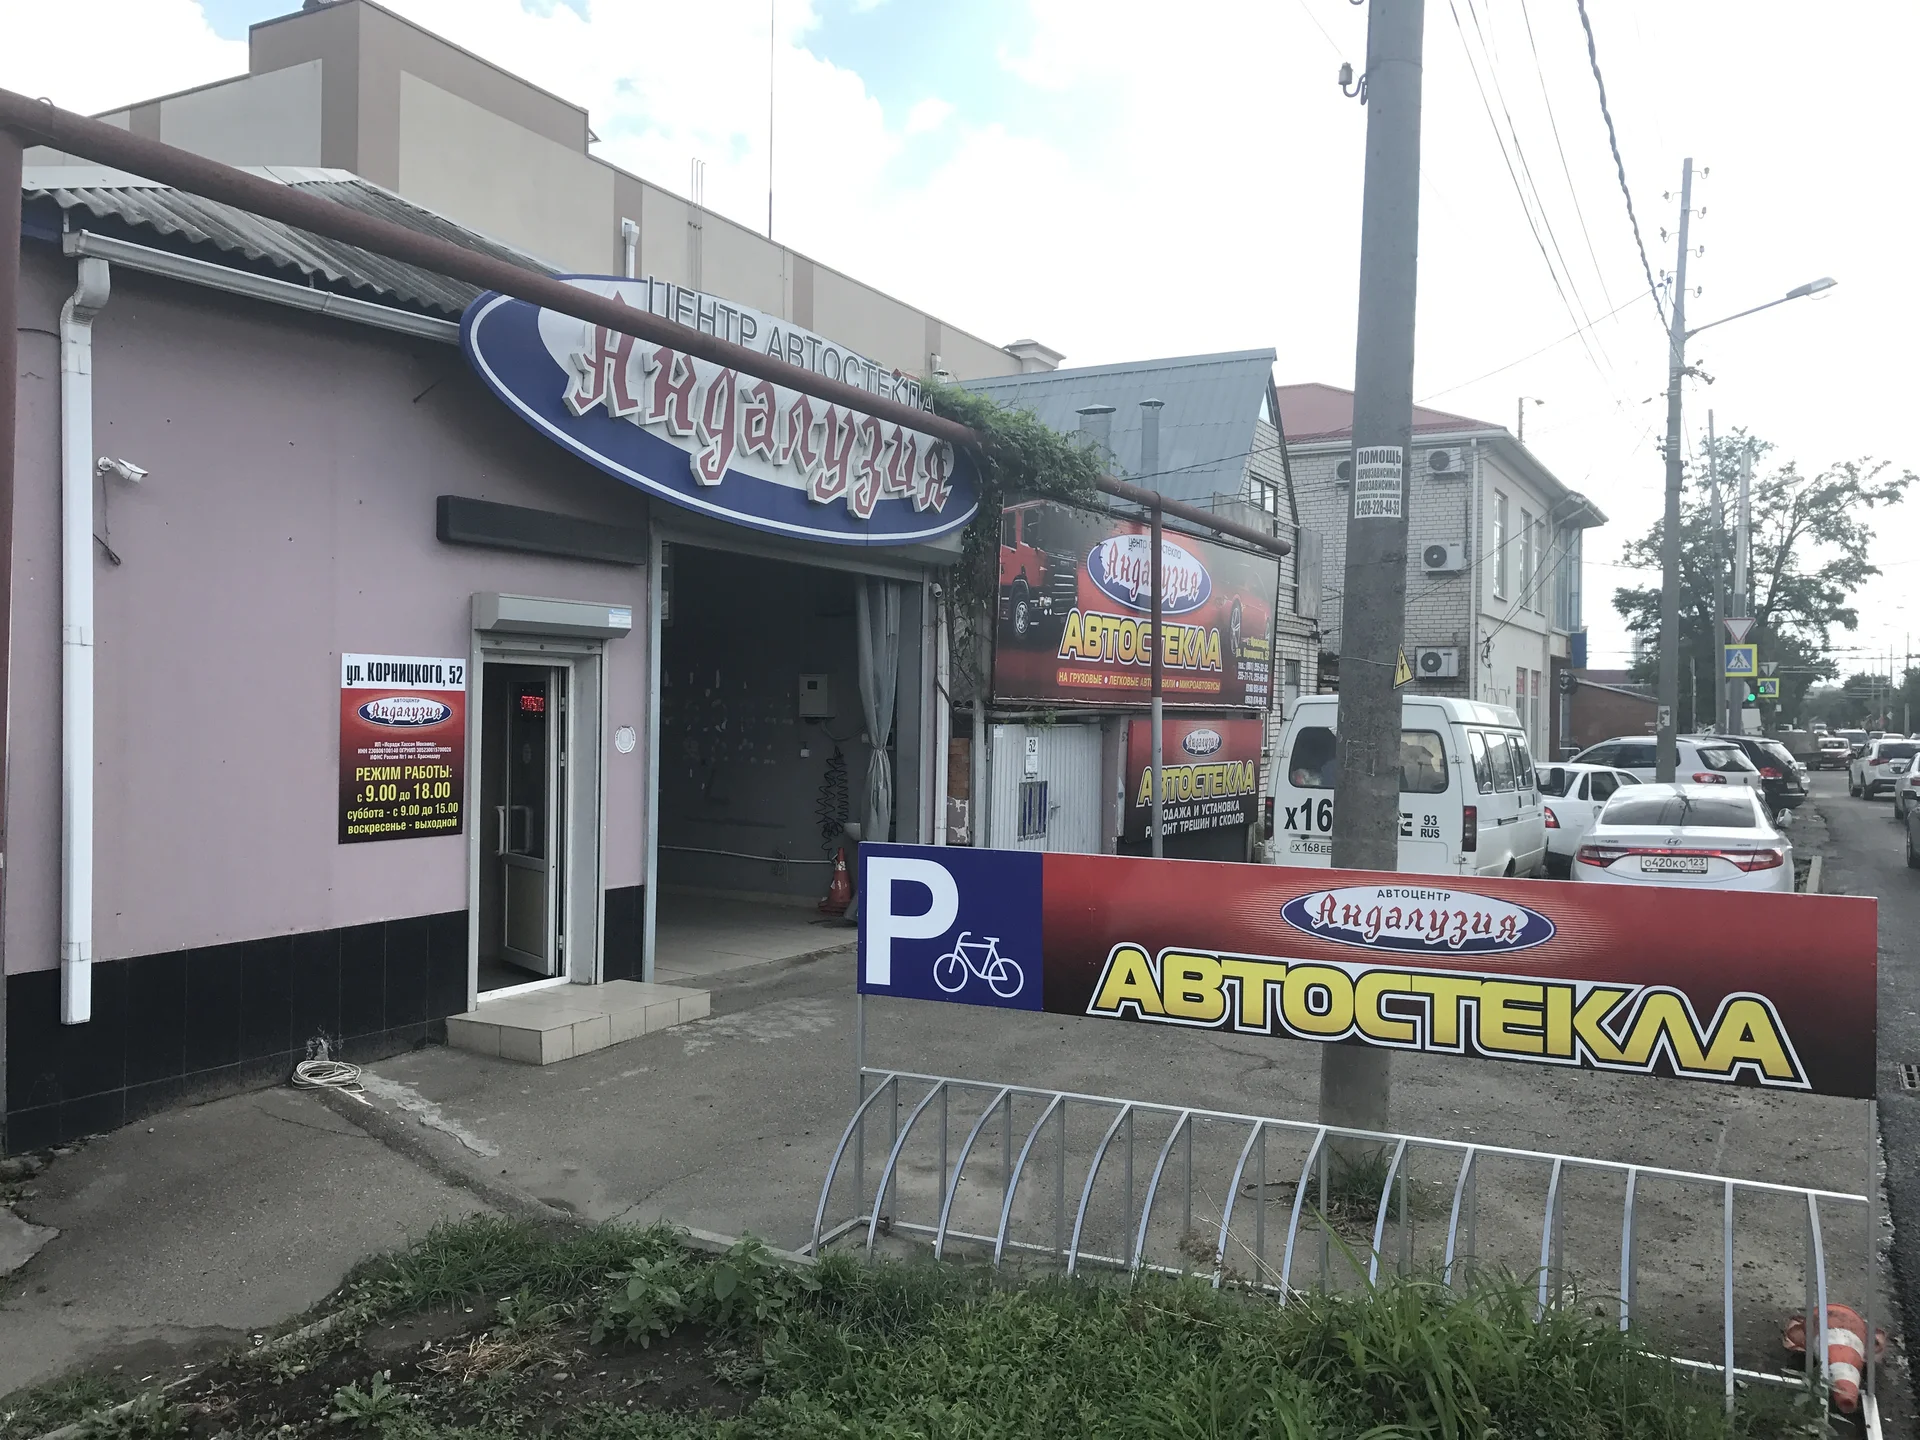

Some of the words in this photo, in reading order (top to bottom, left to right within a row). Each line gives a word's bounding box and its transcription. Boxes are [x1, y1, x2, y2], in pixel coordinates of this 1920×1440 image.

[647, 274, 758, 347] ЦЕНТР
[765, 326, 935, 415] АВТОСТЕКЛА
[1358, 450, 1401, 465] ПОМОЩЬ
[1104, 541, 1200, 607] Андаузия
[1058, 609, 1223, 672] АВТОСЕКЛА
[346, 665, 364, 686] ул.
[367, 662, 446, 687] КОРНИЦКОГО,
[449, 665, 463, 685] 52
[1058, 671, 1068, 682] НА
[1069, 673, 1103, 685] ГРУЗОВЫЕ
[1108, 676, 1139, 687] ЛЕГКОВЫЕ
[369, 702, 443, 724] Андалузия
[356, 766, 401, 782] РЕЖИМ
[404, 765, 453, 780] РАБОТЫ:
[365, 783, 397, 803] 9.00
[398, 791, 411, 802] до
[413, 781, 451, 800] 18.00
[347, 807, 384, 822] суббота
[400, 804, 420, 817] 9.00
[421, 805, 433, 817] до
[435, 801, 459, 815] 15.00
[1193, 803, 1199, 816] И
[1200, 799, 1240, 816] УСТАНОВКА
[347, 821, 407, 836] воскресенье
[414, 815, 457, 831] выходной
[1211, 817, 1218, 828] И
[1219, 812, 1245, 827] СКОЛОВ
[1423, 814, 1438, 826] 93
[1420, 828, 1440, 838] RUS
[1688, 858, 1705, 866] 123
[1377, 888, 1451, 902] АВТОЦЕНТР
[866, 856, 959, 986] P
[1312, 893, 1521, 948] Андалузия
[1087, 942, 1811, 1088] АВТОСТЕКЛА
